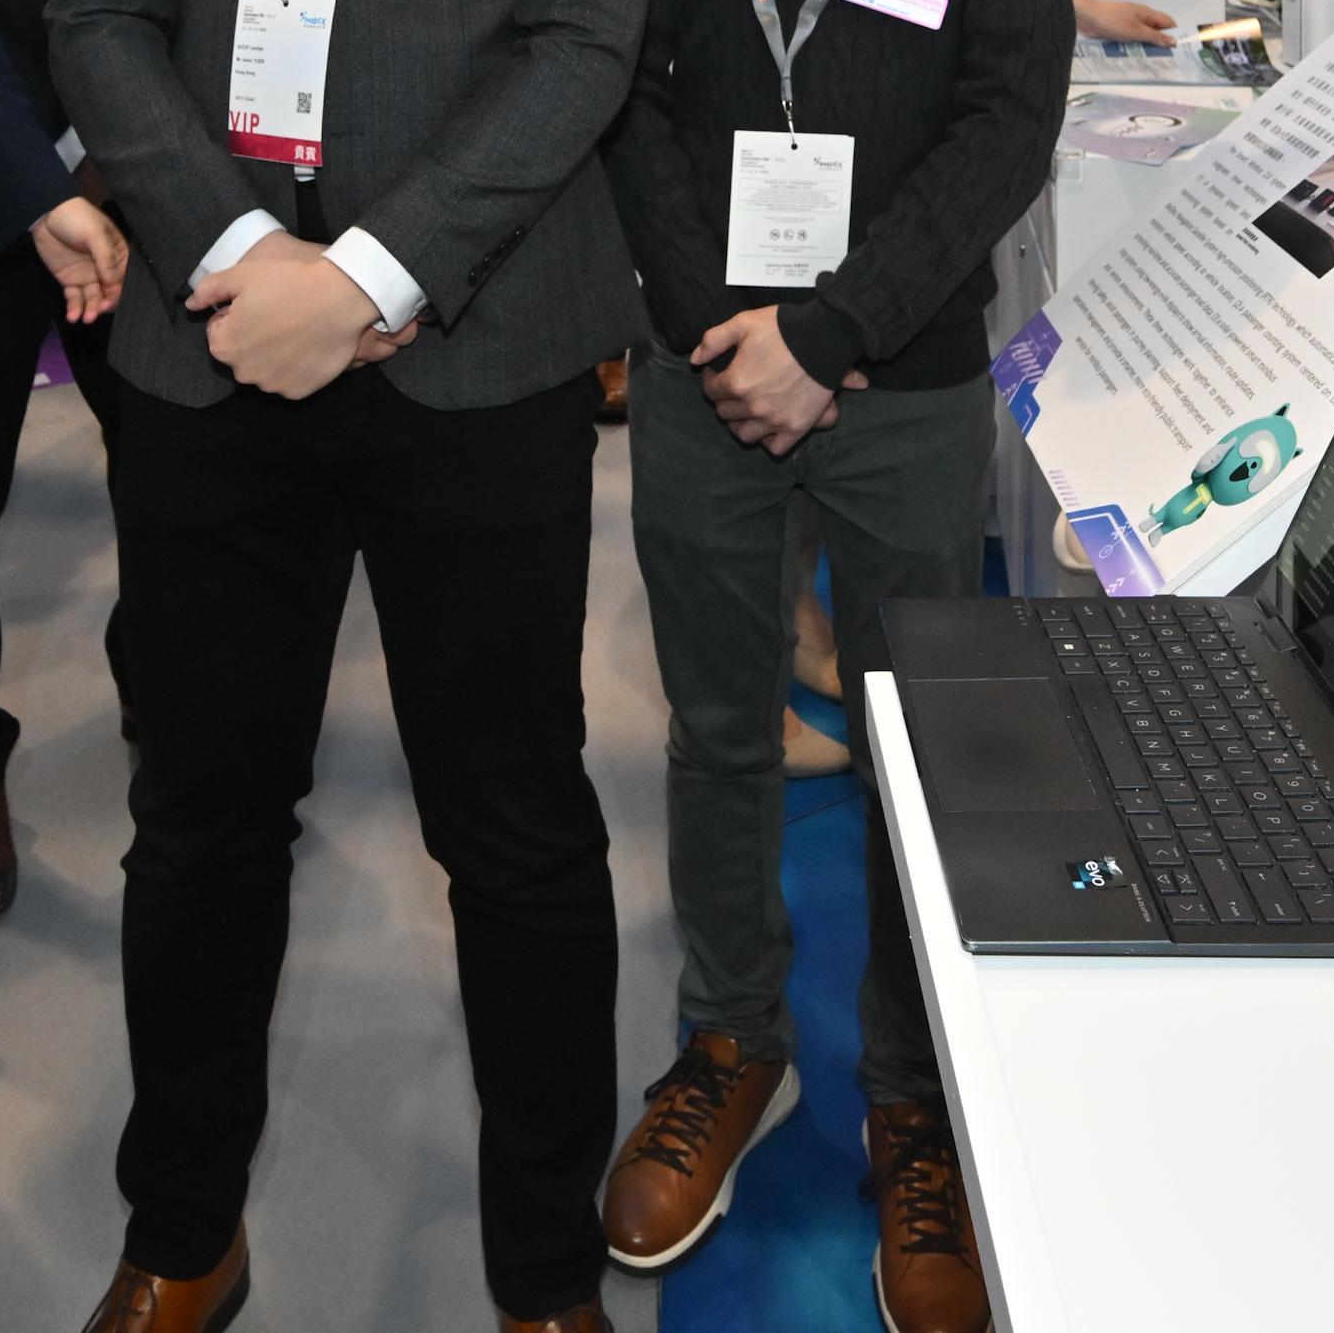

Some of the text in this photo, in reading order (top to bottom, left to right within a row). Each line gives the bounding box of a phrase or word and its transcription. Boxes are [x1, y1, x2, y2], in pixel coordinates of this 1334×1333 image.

[229, 110, 260, 134] VIP
[294, 145, 317, 161] 貴賓
[1085, 861, 1105, 887] evo
